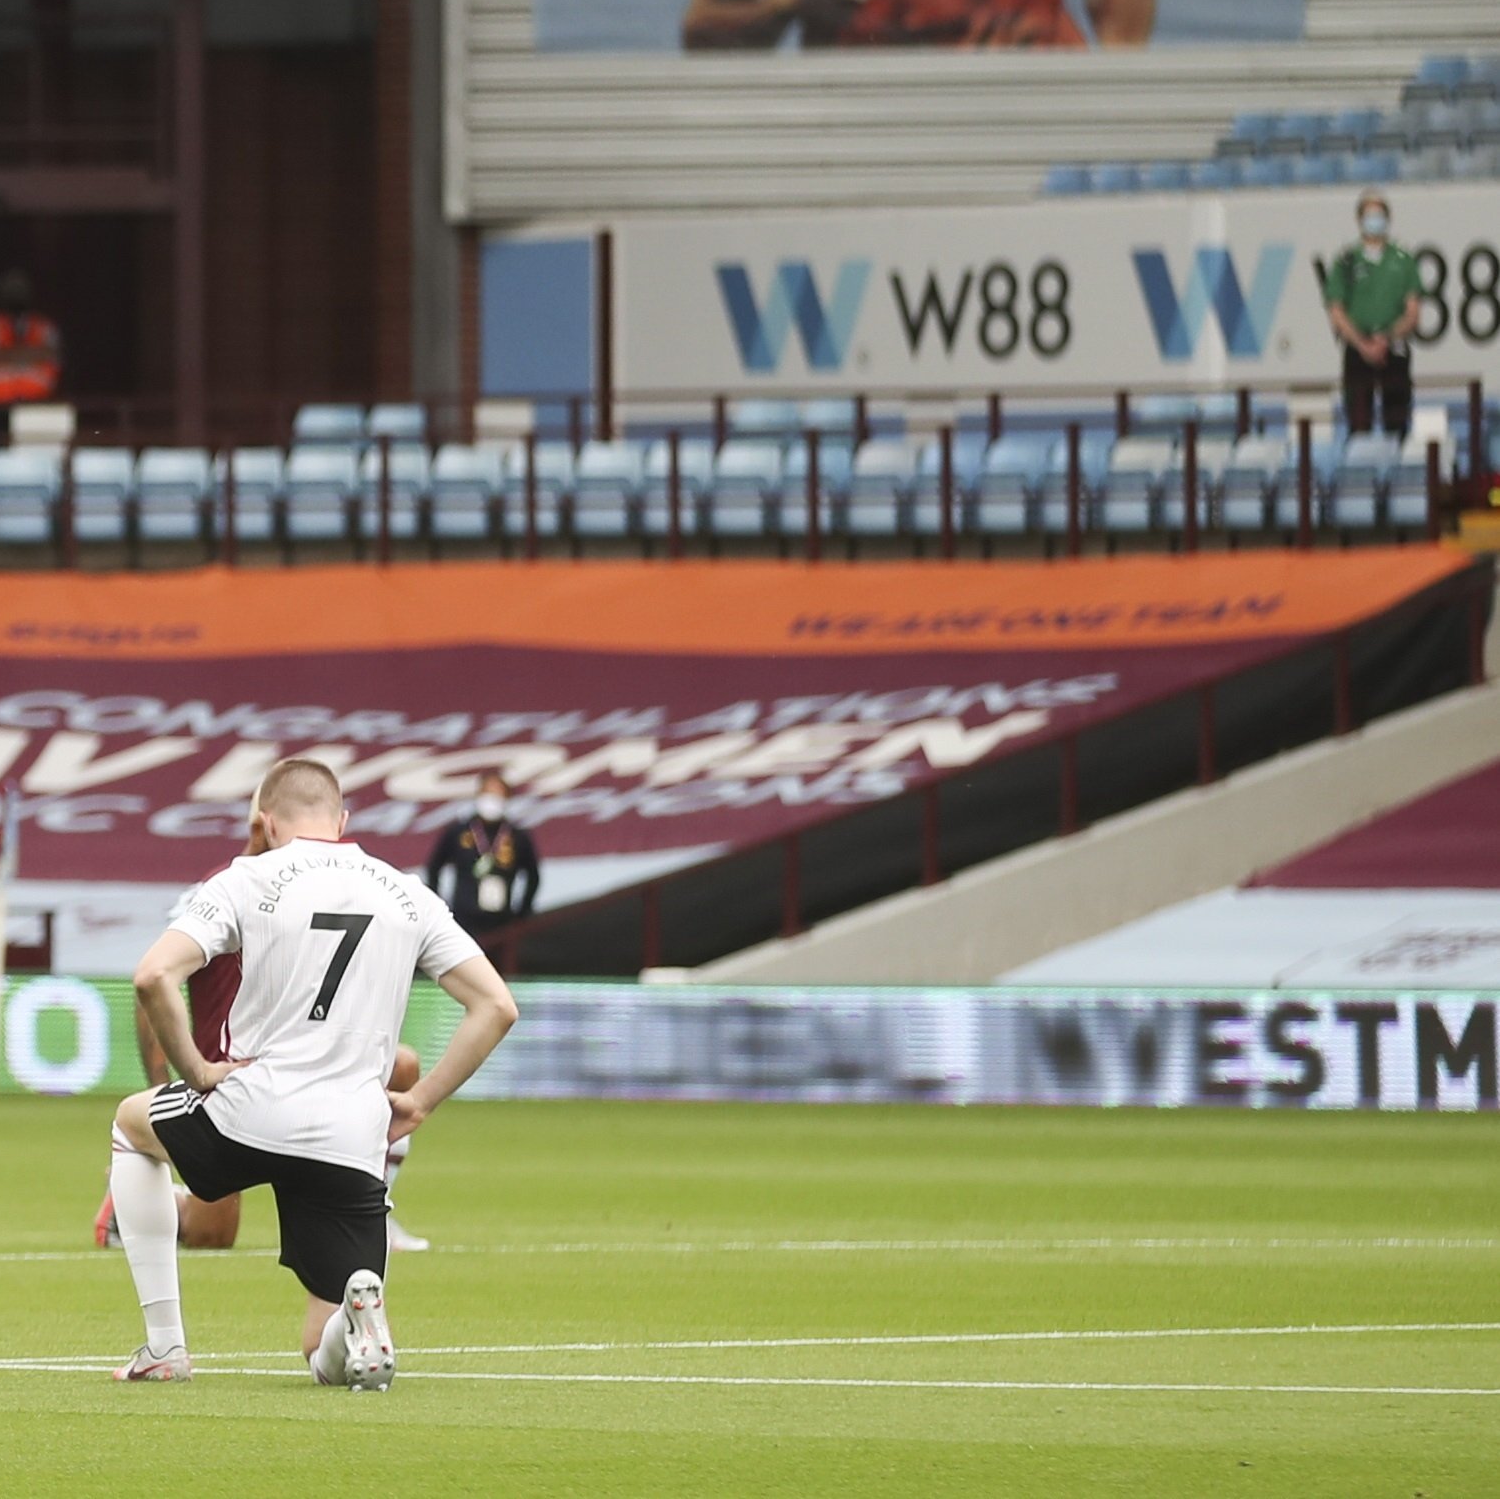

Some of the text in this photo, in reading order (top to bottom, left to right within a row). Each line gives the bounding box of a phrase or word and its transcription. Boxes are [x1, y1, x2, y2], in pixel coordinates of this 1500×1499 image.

[889, 257, 1074, 360] W88
[188, 708, 1050, 800] WOMEN
[147, 762, 908, 840] CAMPIONS
[258, 856, 419, 924] BLACK LIVES MATTER
[308, 913, 375, 1022] 7
